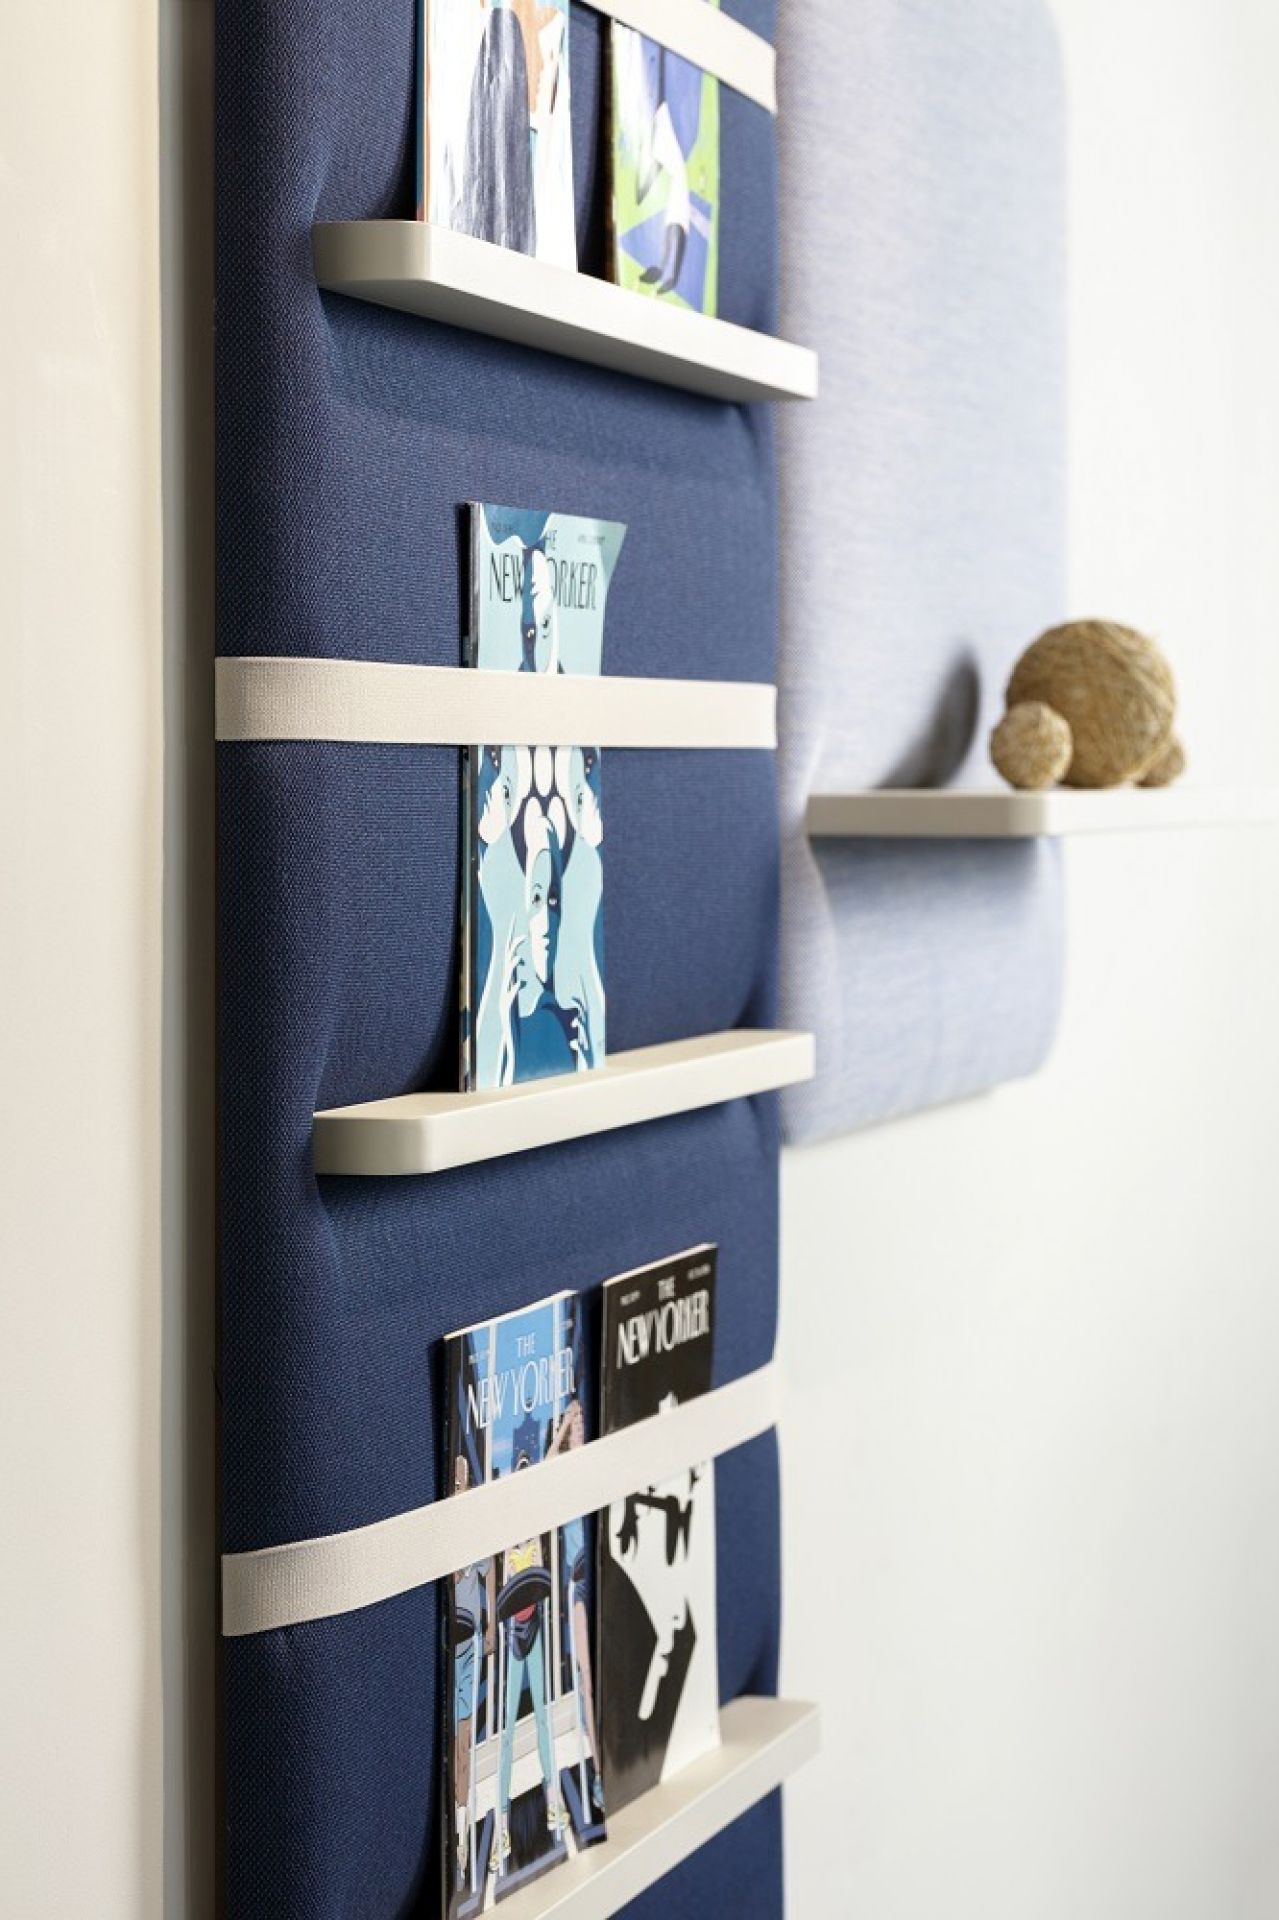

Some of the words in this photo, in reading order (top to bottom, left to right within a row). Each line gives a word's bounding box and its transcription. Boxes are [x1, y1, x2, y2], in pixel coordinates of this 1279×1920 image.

[489, 552, 523, 602] NEW
[546, 557, 598, 610] ORKER
[515, 1332, 534, 1357] THE
[615, 1312, 653, 1369] NEW
[466, 1371, 510, 1435] NEW
